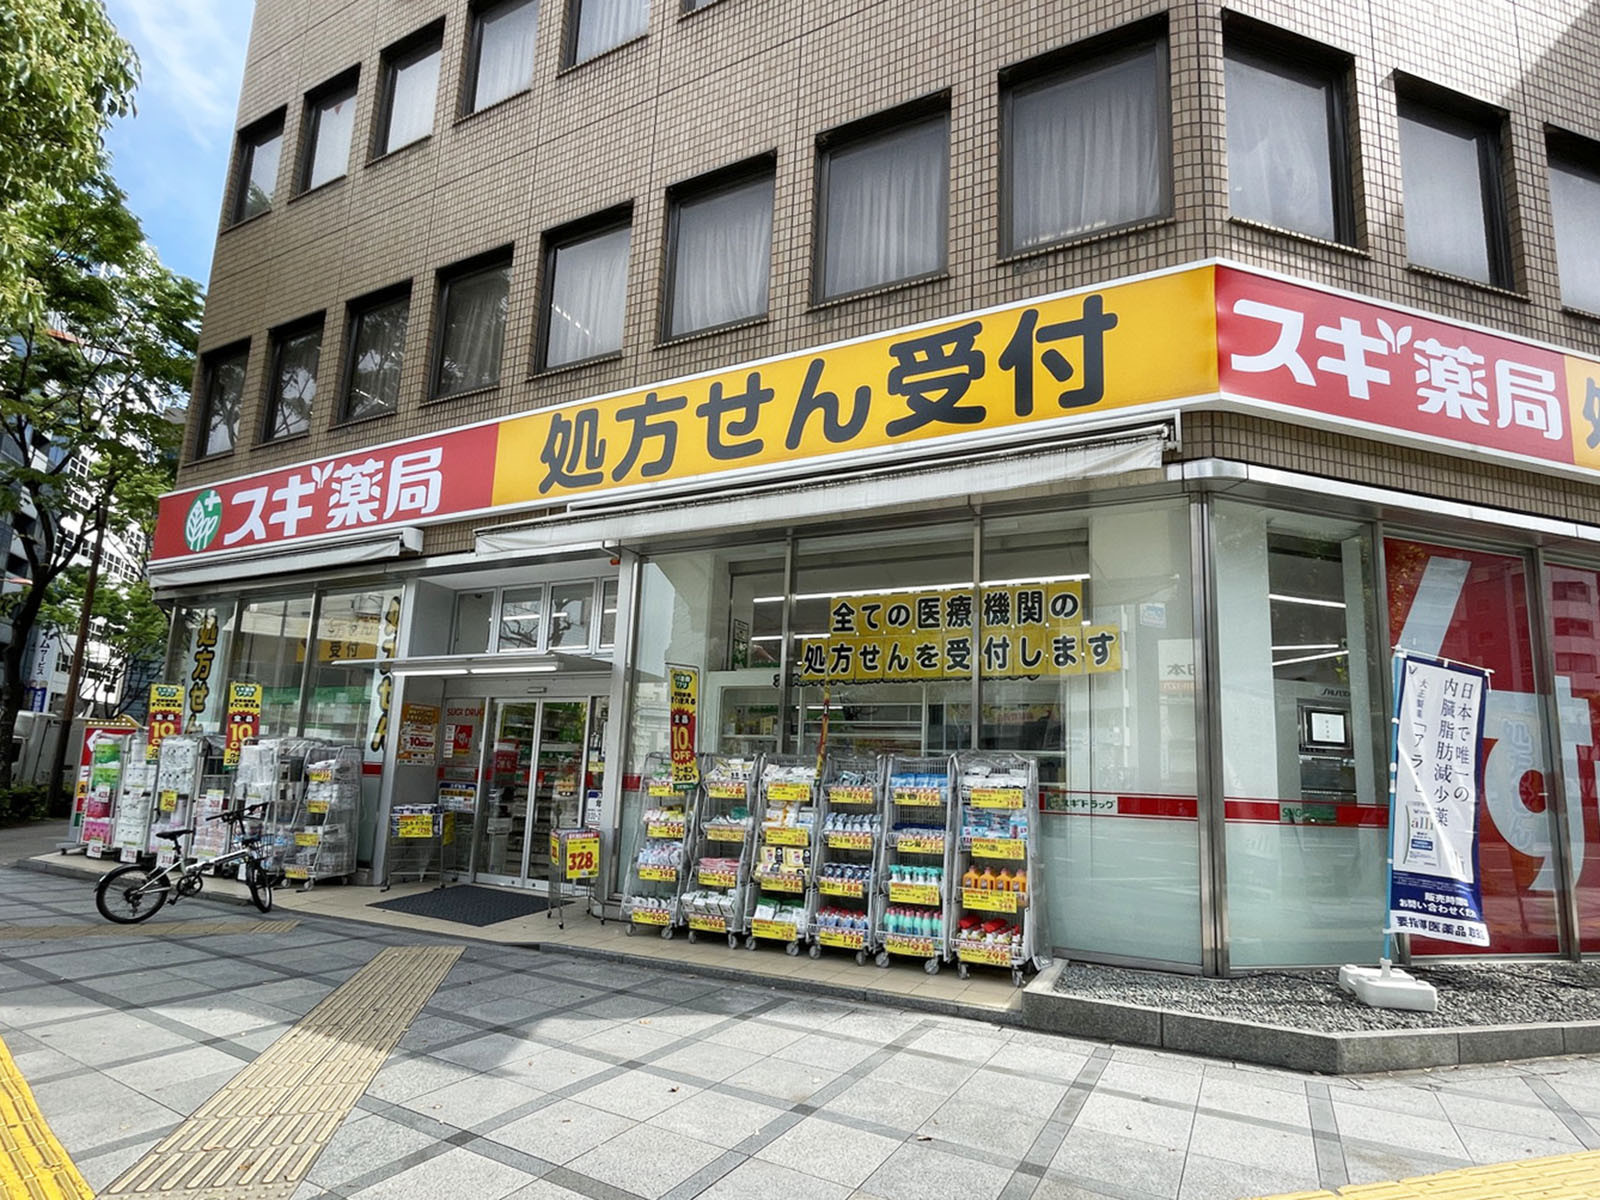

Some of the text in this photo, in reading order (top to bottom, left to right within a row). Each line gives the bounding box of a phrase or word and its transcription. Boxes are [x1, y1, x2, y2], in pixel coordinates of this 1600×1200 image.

[1230, 299, 1563, 440] スギ薬局
[538, 294, 1118, 495] 処方せん受付
[223, 447, 443, 546] スギ薬局
[832, 590, 1078, 632] 全ての医療機関の
[803, 633, 1115, 674] 処方せんを受付します
[184, 615, 218, 735] 処方せん
[673, 750, 692, 761] OFF
[1410, 721, 1427, 793] 「アラ」
[1433, 678, 1459, 827] 内臓脂肪減少薬
[1453, 682, 1474, 802] 日本で唯一の
[1064, 799, 1115, 809] スギドラッグ
[568, 851, 593, 870] 328
[843, 936, 862, 944] 178
[911, 943, 931, 952] 98
[986, 950, 1007, 960] 298
